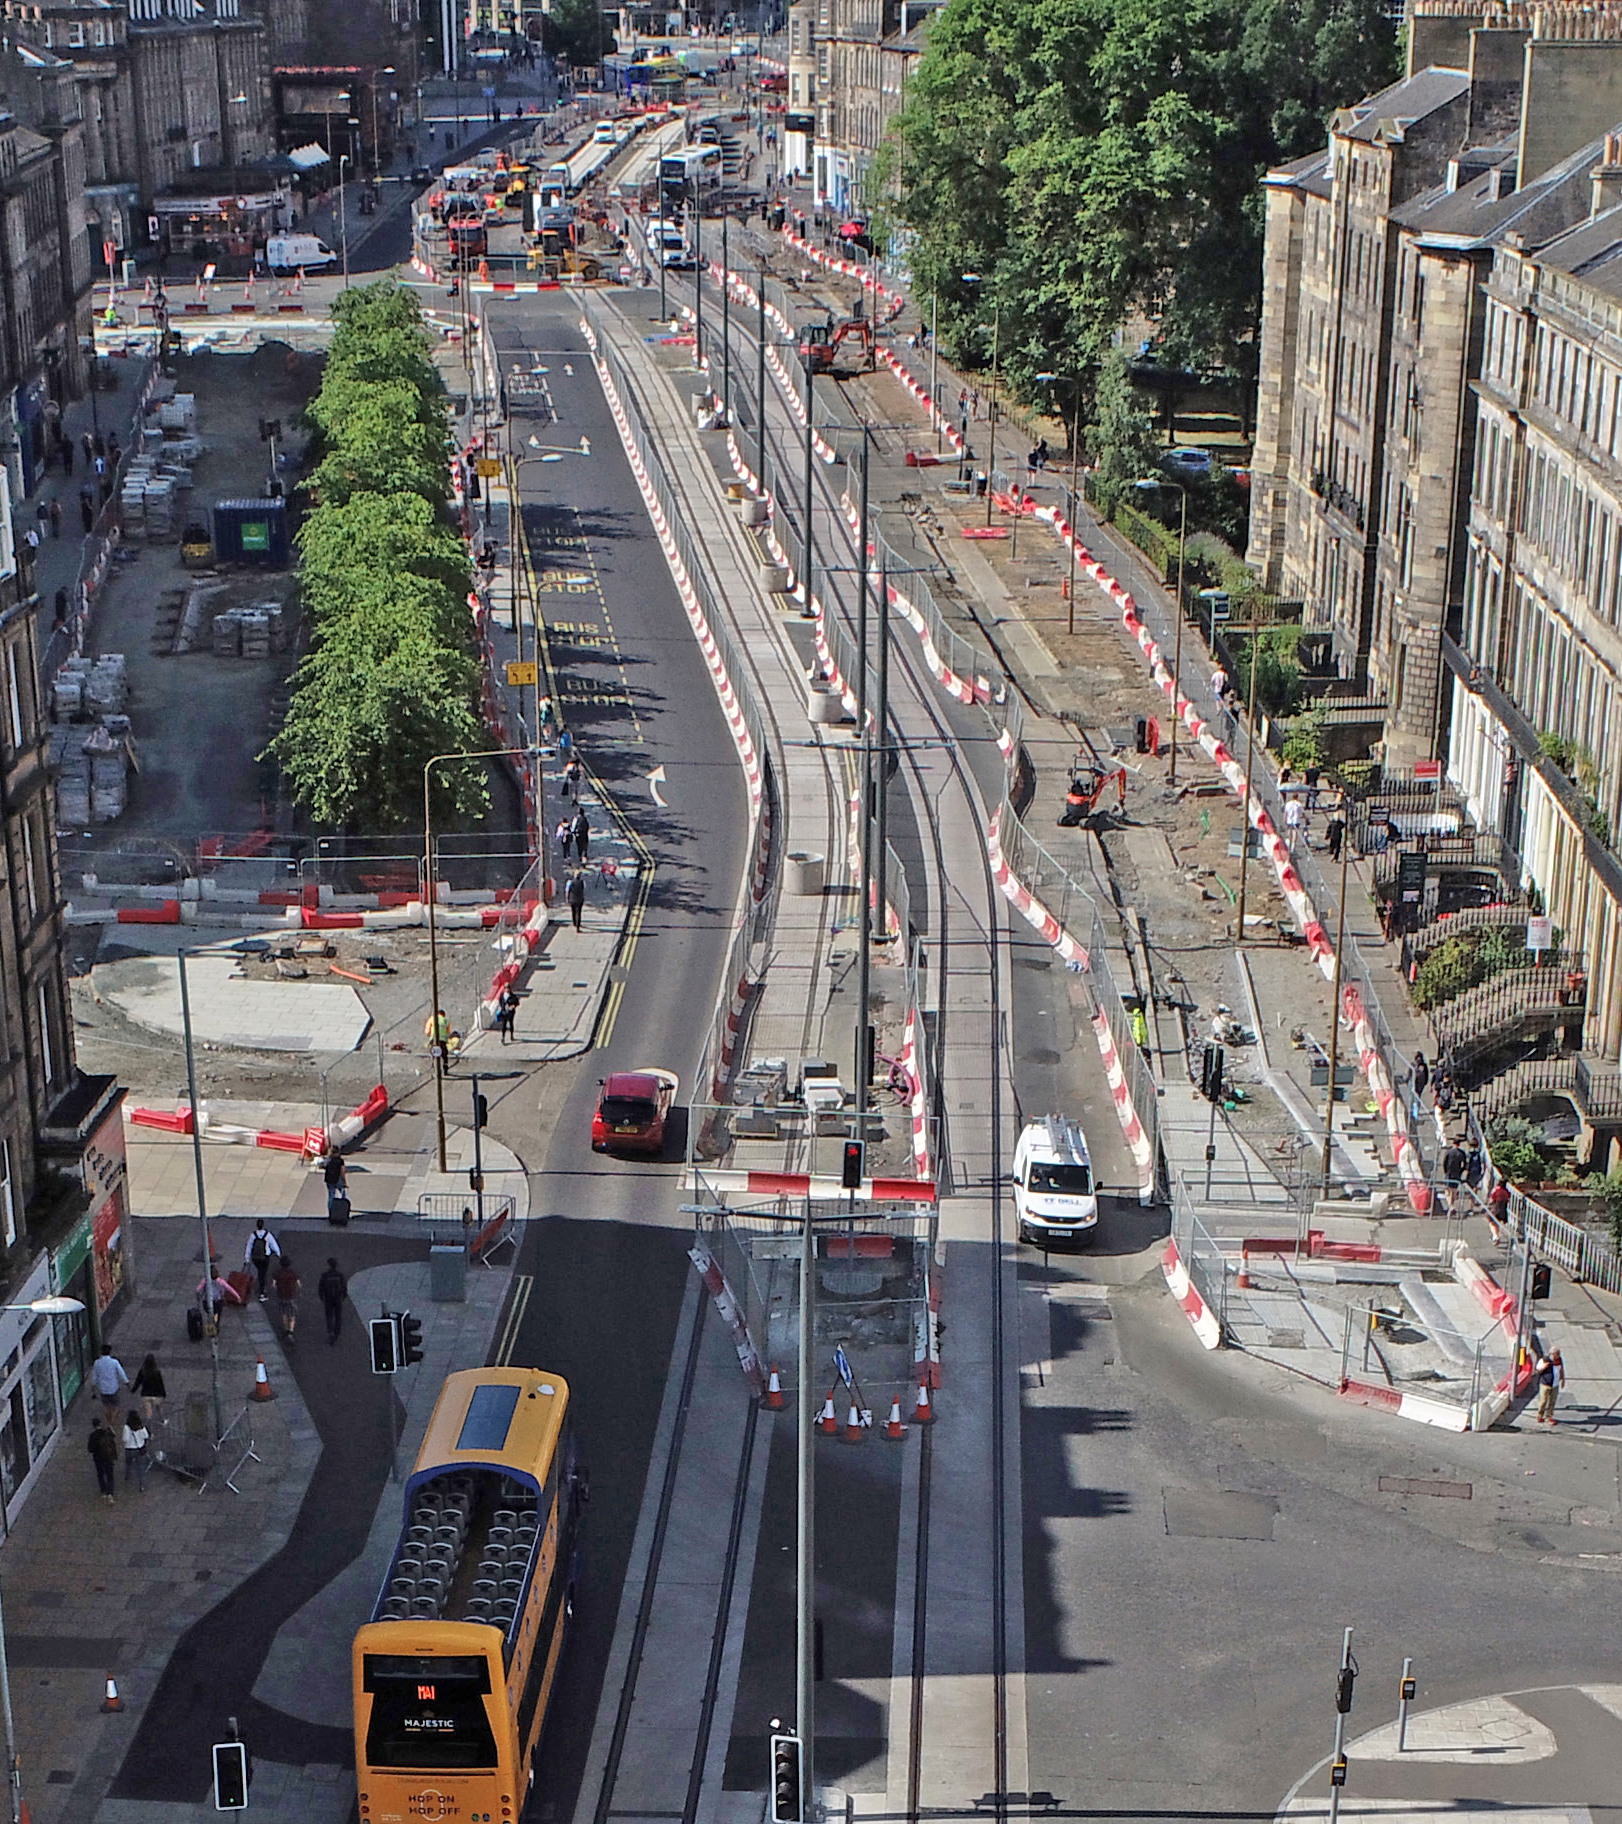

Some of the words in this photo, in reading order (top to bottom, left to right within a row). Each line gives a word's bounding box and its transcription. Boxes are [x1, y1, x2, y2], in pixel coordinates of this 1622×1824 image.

[404, 1719, 455, 1728] MAJESTIC
[408, 1795, 433, 1803] HOP
[437, 1795, 455, 1803] ON
[409, 1807, 434, 1815] HOP
[438, 1807, 460, 1816] OFF
